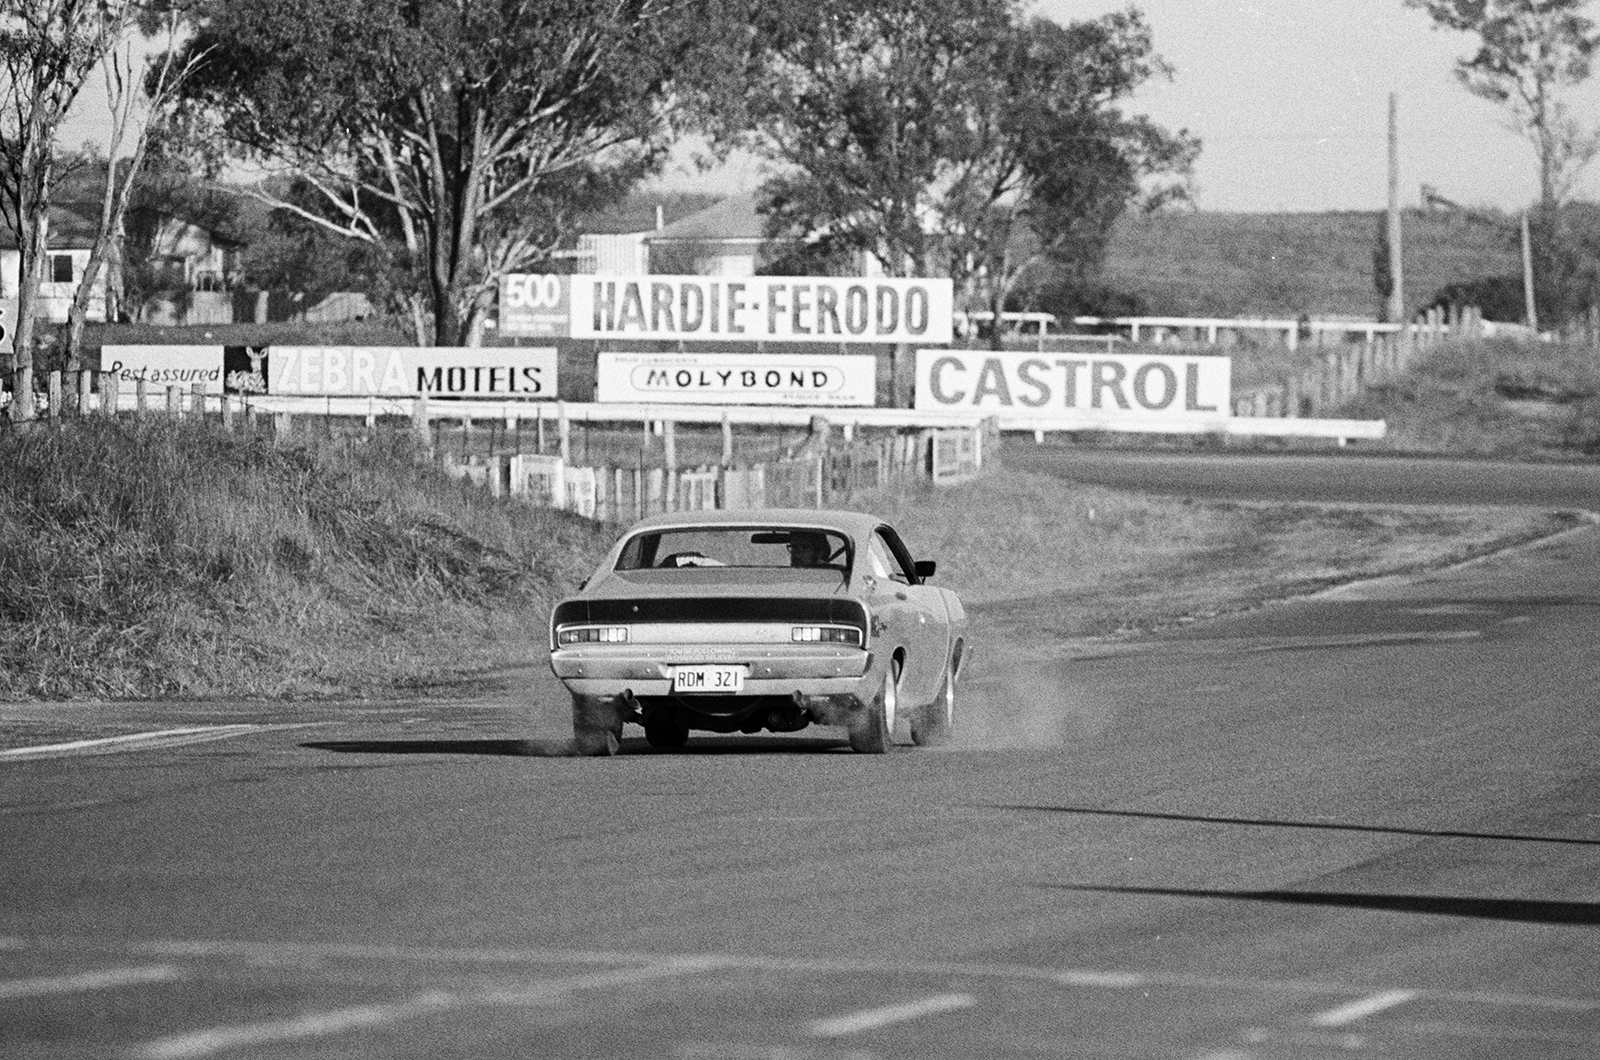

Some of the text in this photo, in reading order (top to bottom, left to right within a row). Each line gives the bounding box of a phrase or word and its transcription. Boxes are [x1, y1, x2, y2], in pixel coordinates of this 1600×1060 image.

[506, 273, 560, 308] 500
[151, 365, 221, 382] assured
[276, 348, 542, 394] ZEBRA MOTELS
[646, 369, 828, 388] MOLYBOND
[929, 356, 1218, 412] CASTROL
[677, 671, 738, 687] RDM 321
